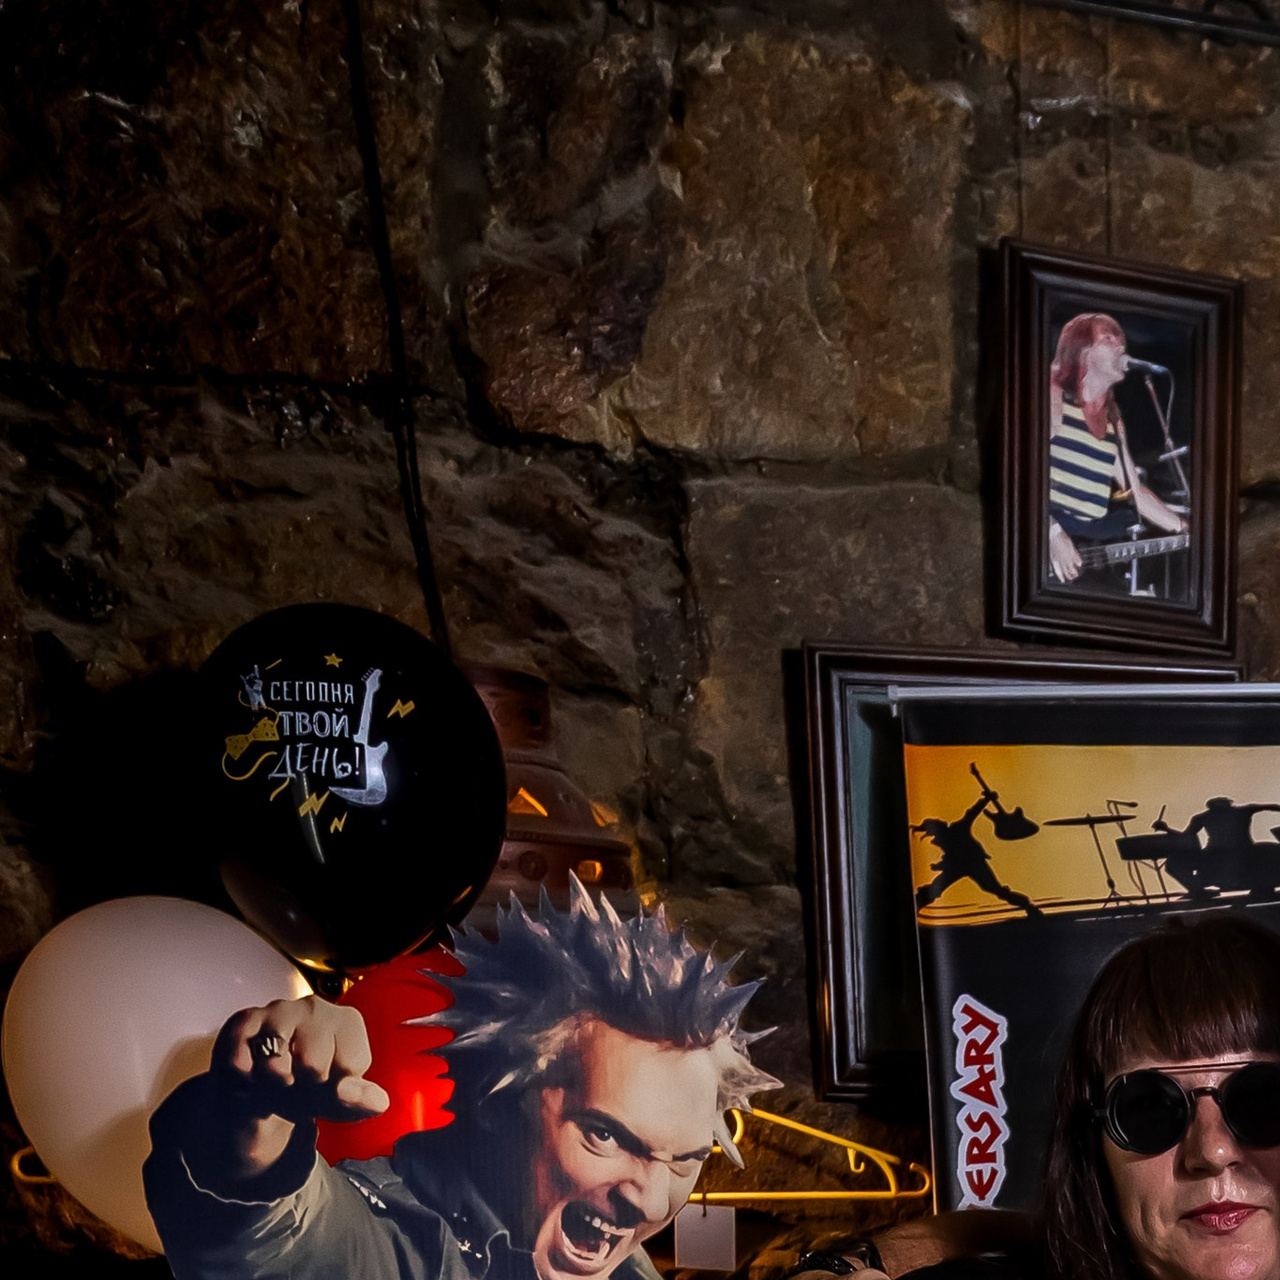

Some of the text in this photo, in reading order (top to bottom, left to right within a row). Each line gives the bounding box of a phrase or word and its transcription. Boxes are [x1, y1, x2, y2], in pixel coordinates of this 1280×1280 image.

[269, 680, 355, 704] СЕГОДНЯ
[278, 707, 350, 738] ТВОЙ
[267, 742, 361, 780] ДЕНЬ!
[955, 999, 1005, 1209] ERSARY
